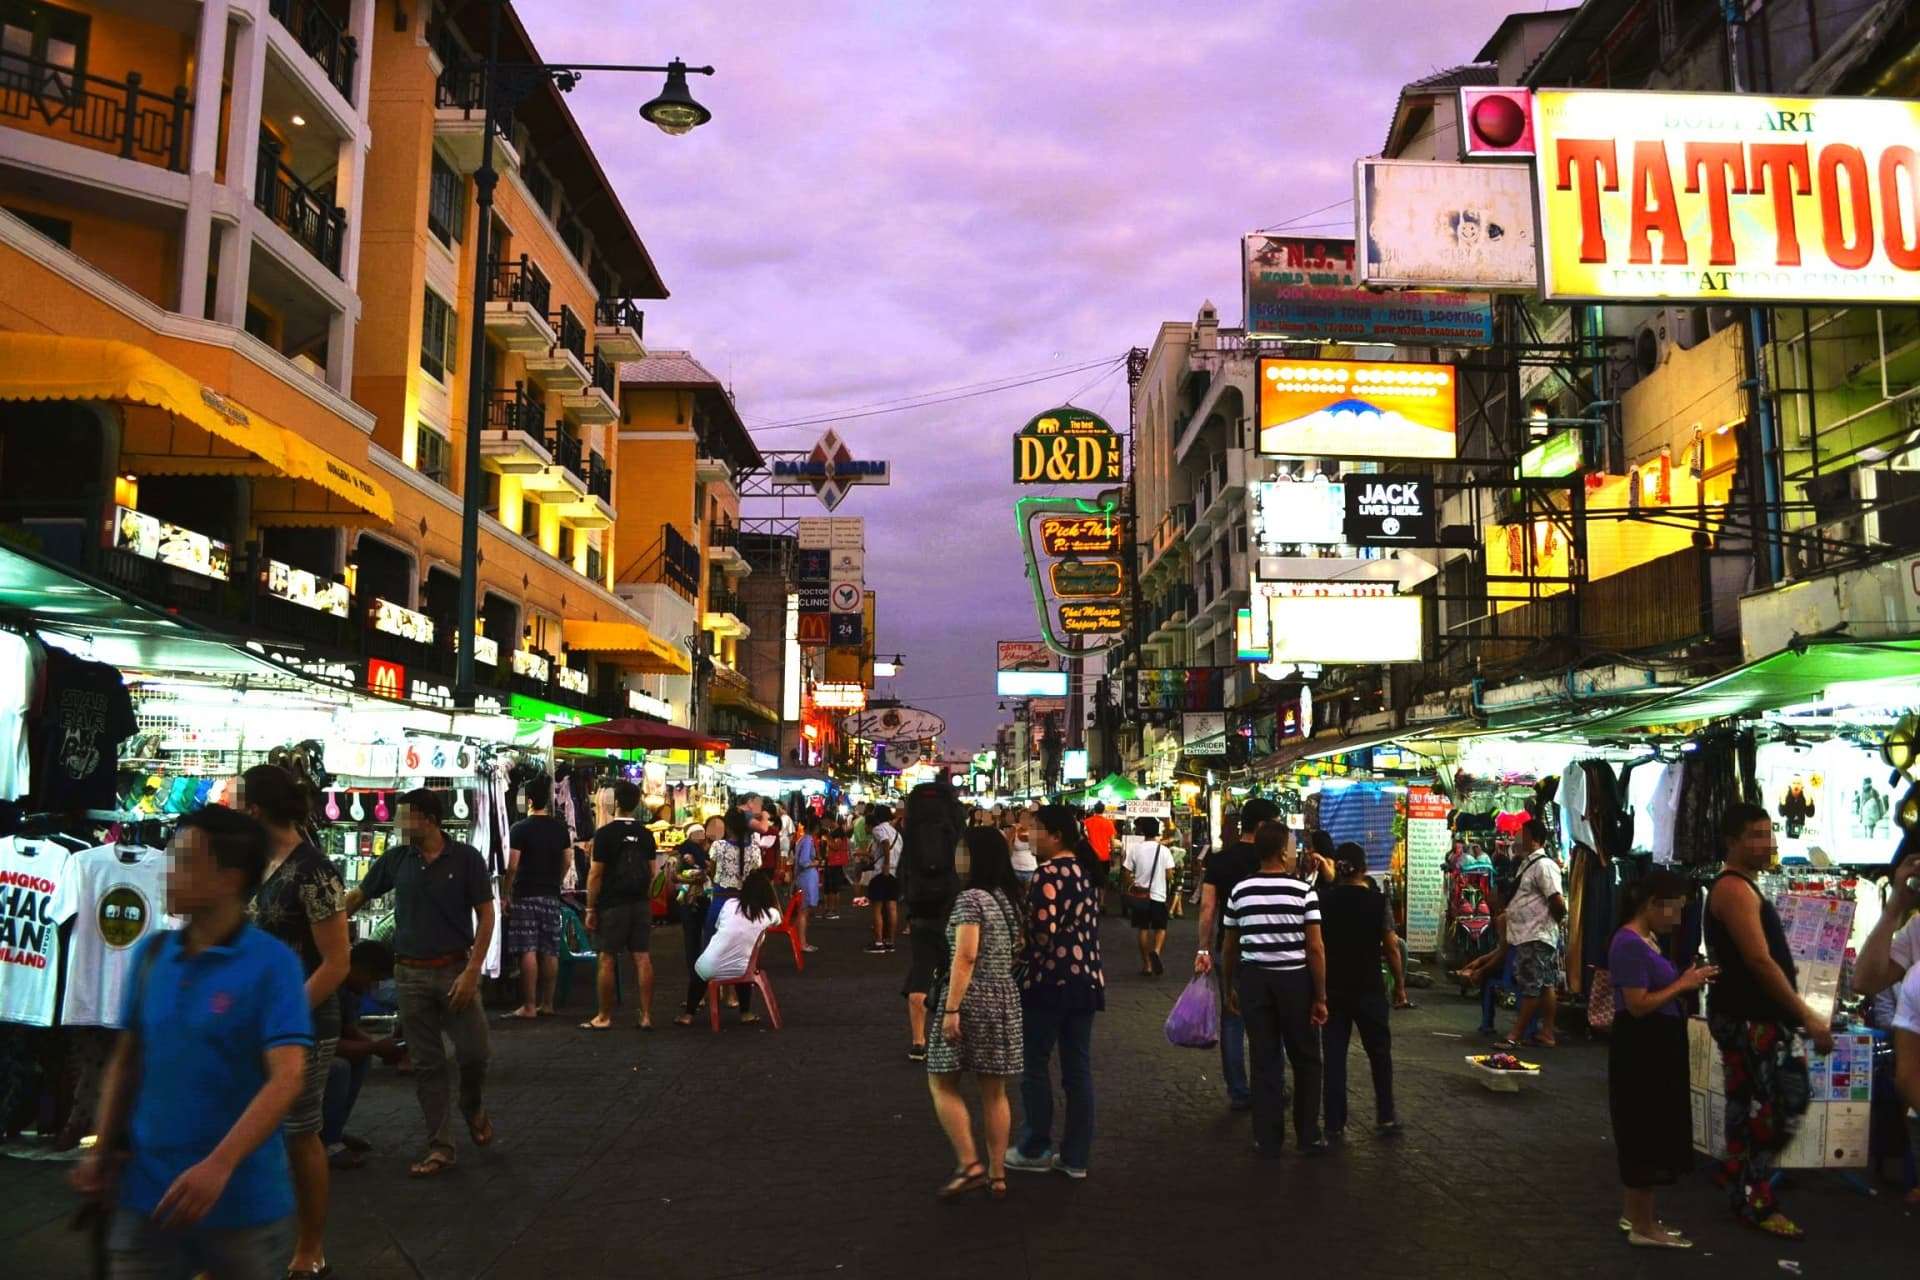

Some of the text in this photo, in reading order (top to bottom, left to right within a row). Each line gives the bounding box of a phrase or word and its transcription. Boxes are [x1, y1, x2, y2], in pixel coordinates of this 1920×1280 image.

[1757, 111, 1816, 132] ART
[1556, 137, 1920, 271] TATTOO
[1389, 309, 1424, 321] HOTEL
[1429, 310, 1483, 323] BOOKING
[1019, 435, 1119, 481] D&D INN
[1358, 484, 1419, 505] JACK
[799, 588, 829, 596] DOCTOR
[799, 598, 829, 607] CLINIC
[1083, 606, 1121, 618] Massage
[839, 625, 853, 635] 24
